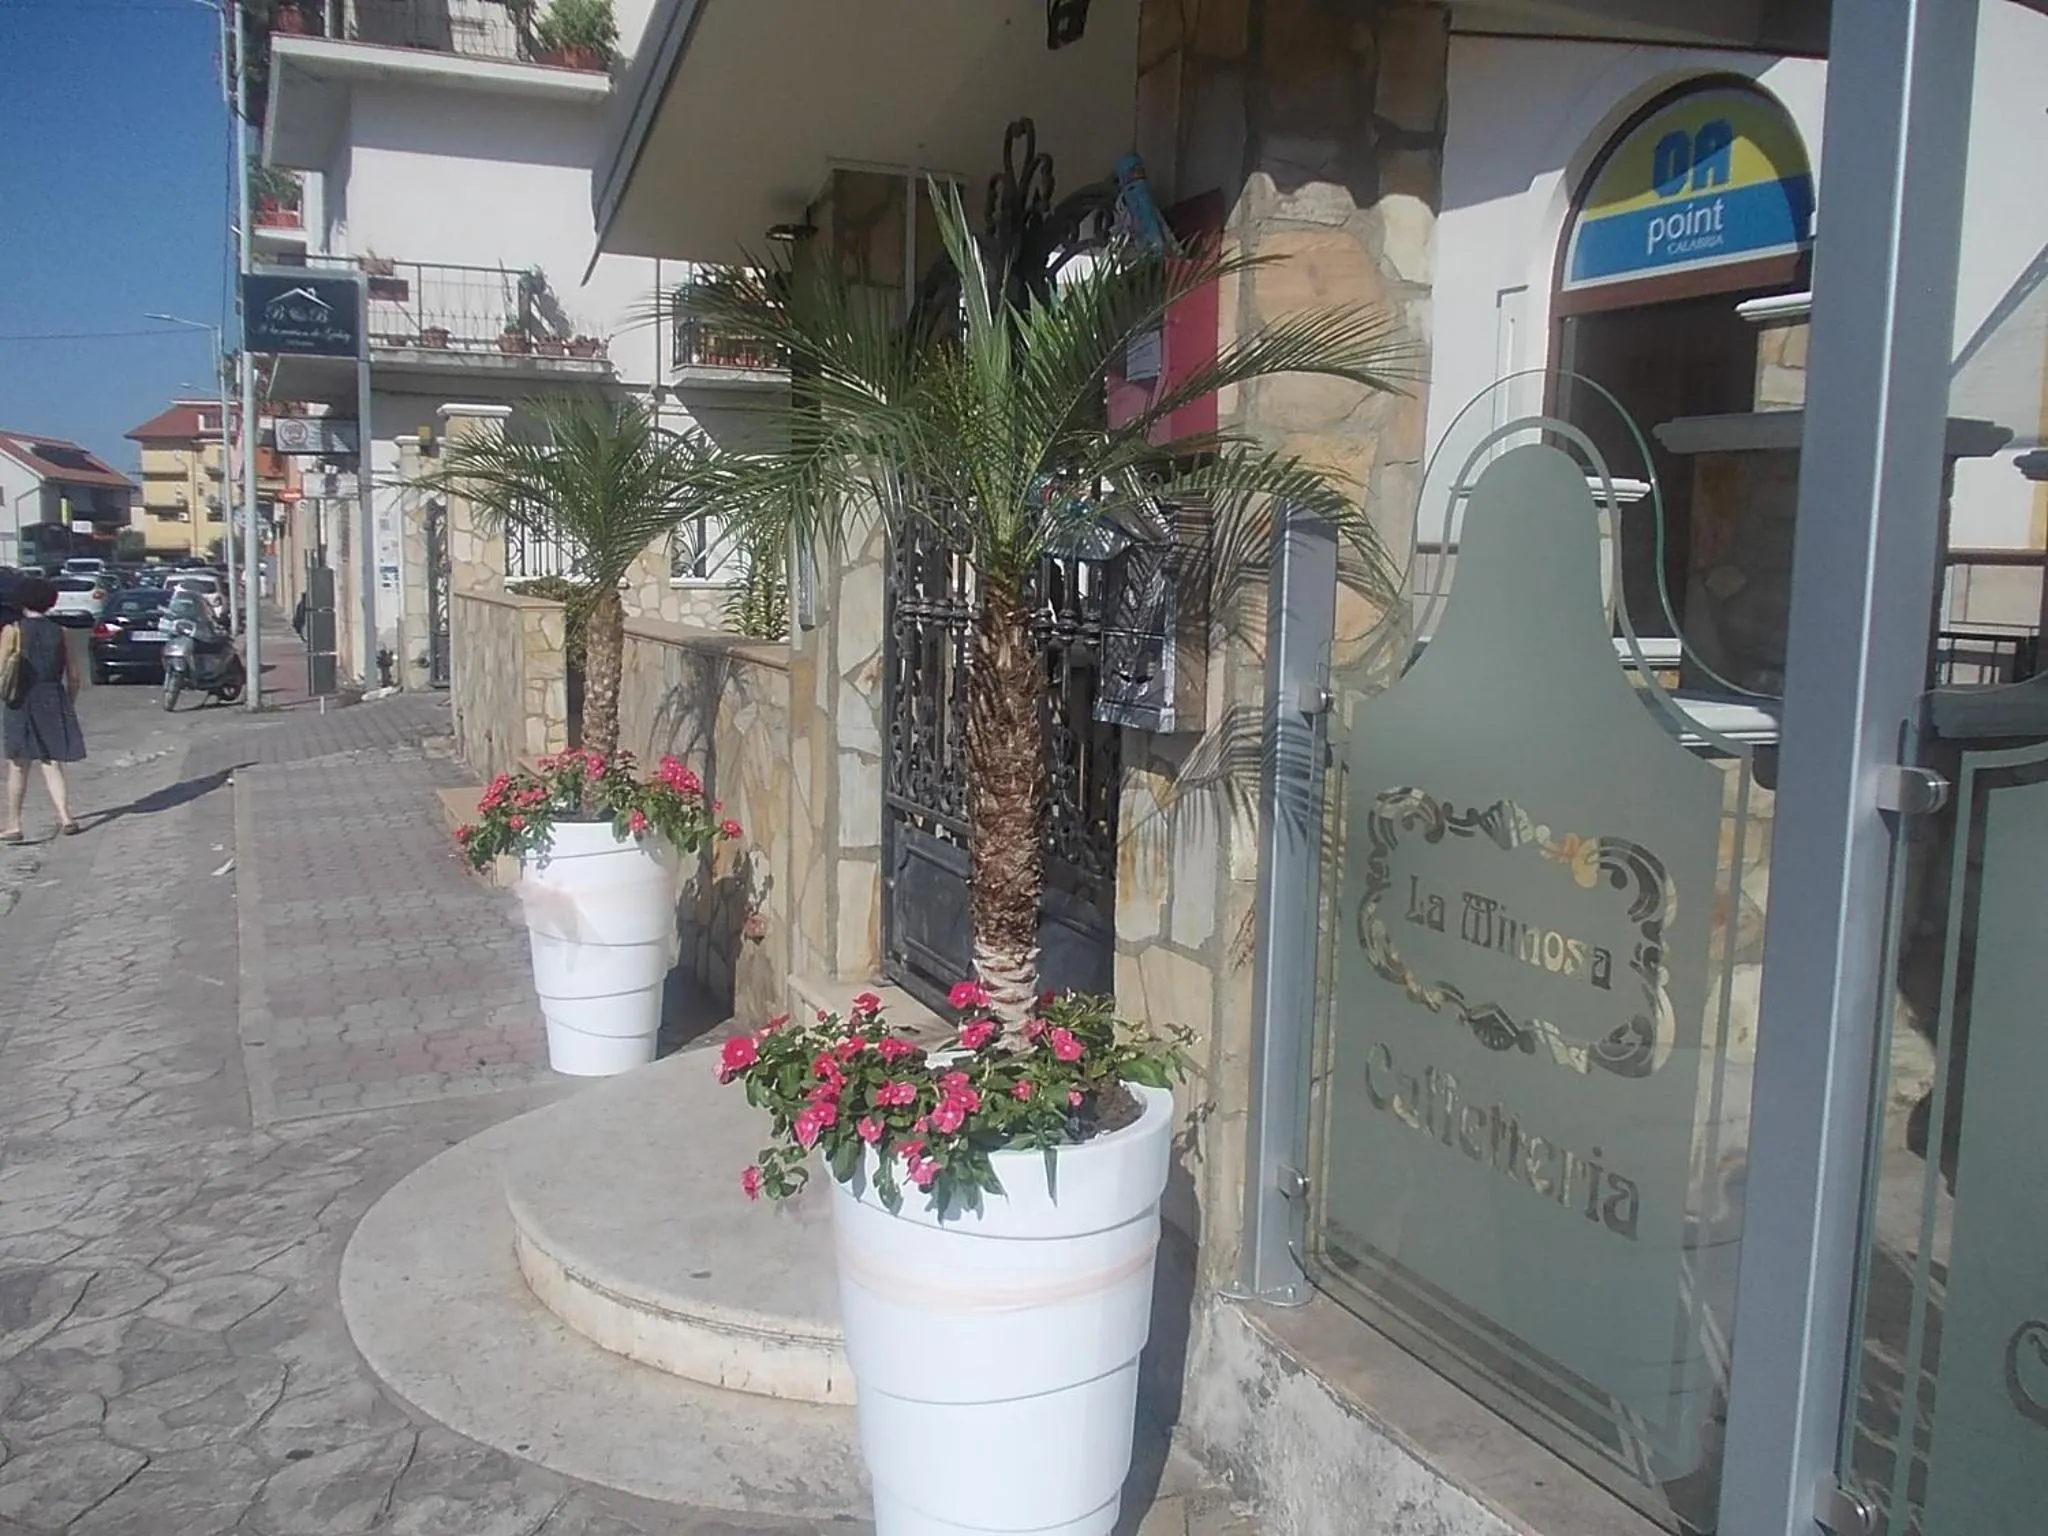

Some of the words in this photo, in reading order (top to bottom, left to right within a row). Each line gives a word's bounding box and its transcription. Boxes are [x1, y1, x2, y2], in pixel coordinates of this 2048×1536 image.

[1646, 198, 1725, 255] point
[1404, 873, 1446, 933] La
[1461, 891, 1613, 991] Mimosa
[1364, 1042, 1640, 1242] Caffetteria
